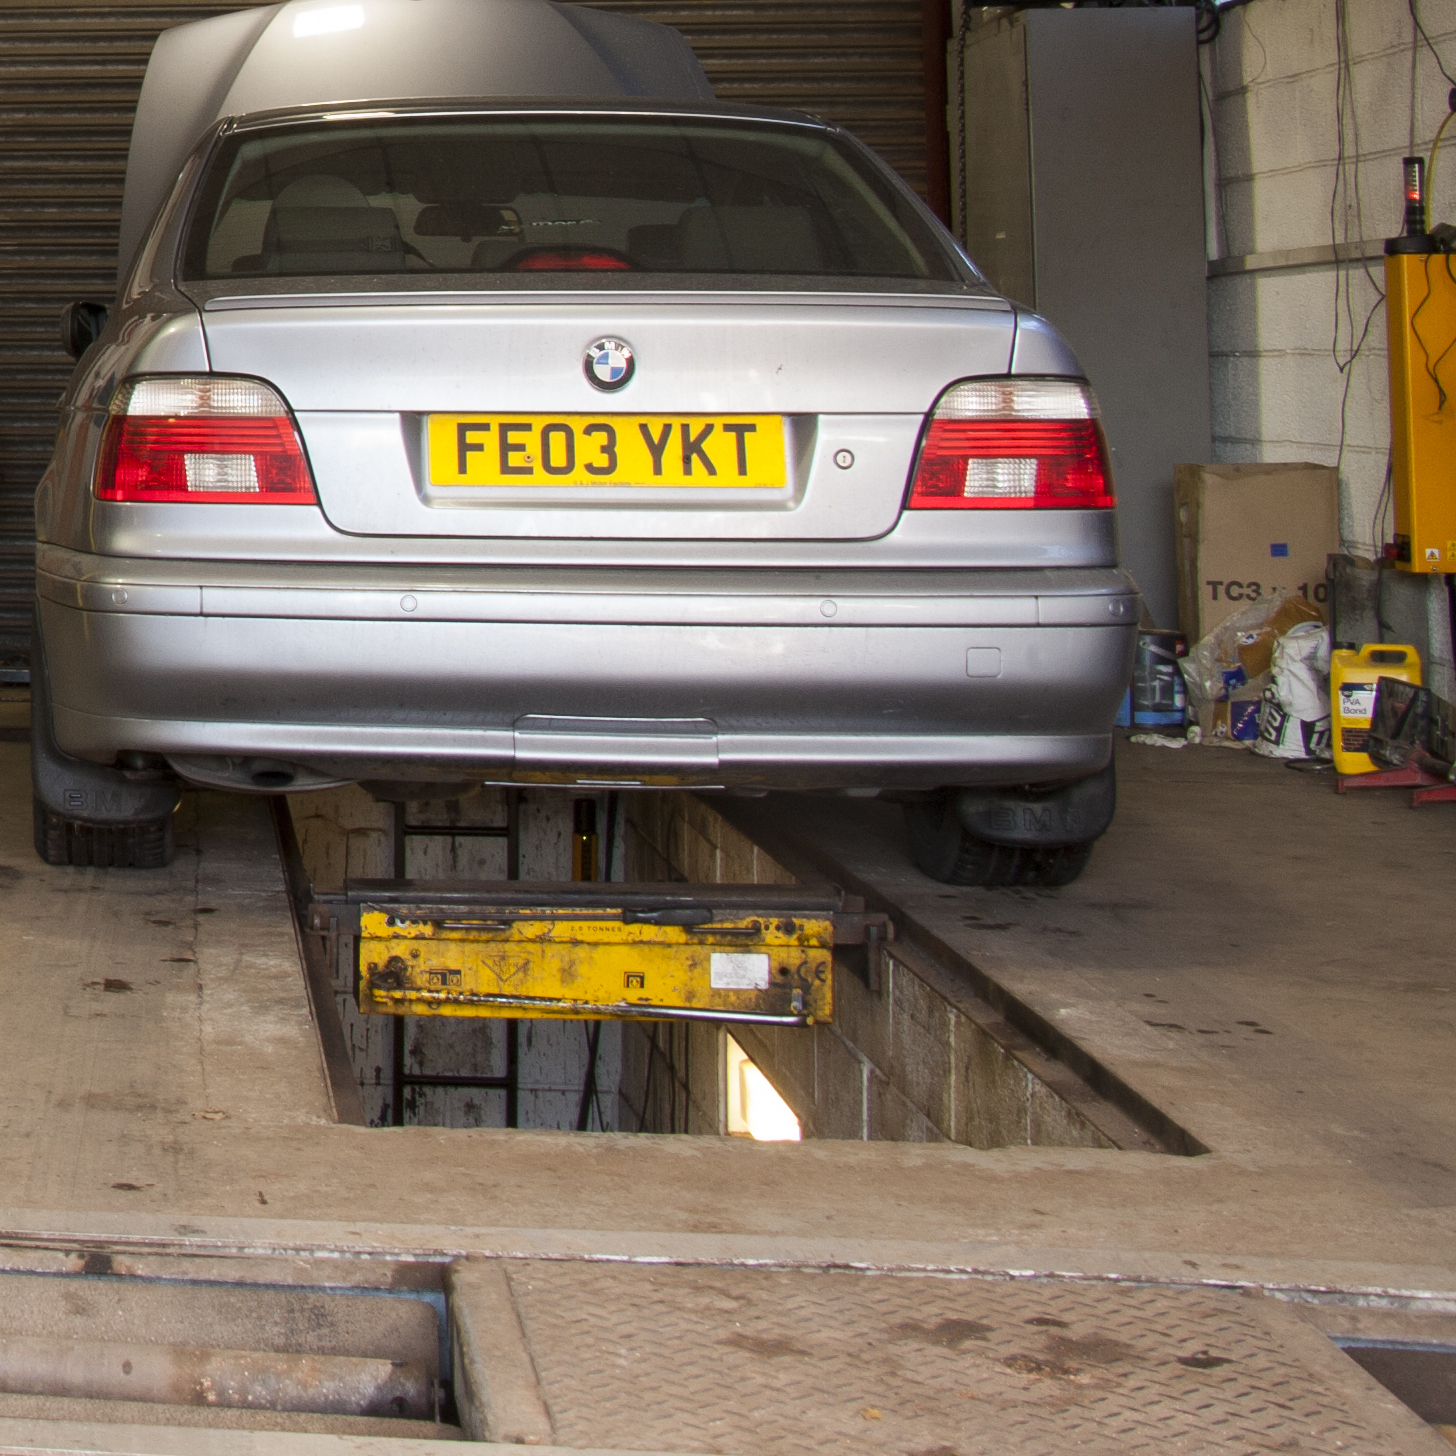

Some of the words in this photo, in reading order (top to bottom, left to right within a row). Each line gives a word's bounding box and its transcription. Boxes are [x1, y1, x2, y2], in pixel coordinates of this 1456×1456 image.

[457, 423, 618, 475] FE03
[638, 423, 757, 476] YKT
[1206, 580, 1262, 602] TC3
[1343, 707, 1367, 716] Bond
[587, 925, 623, 933] TONNES
